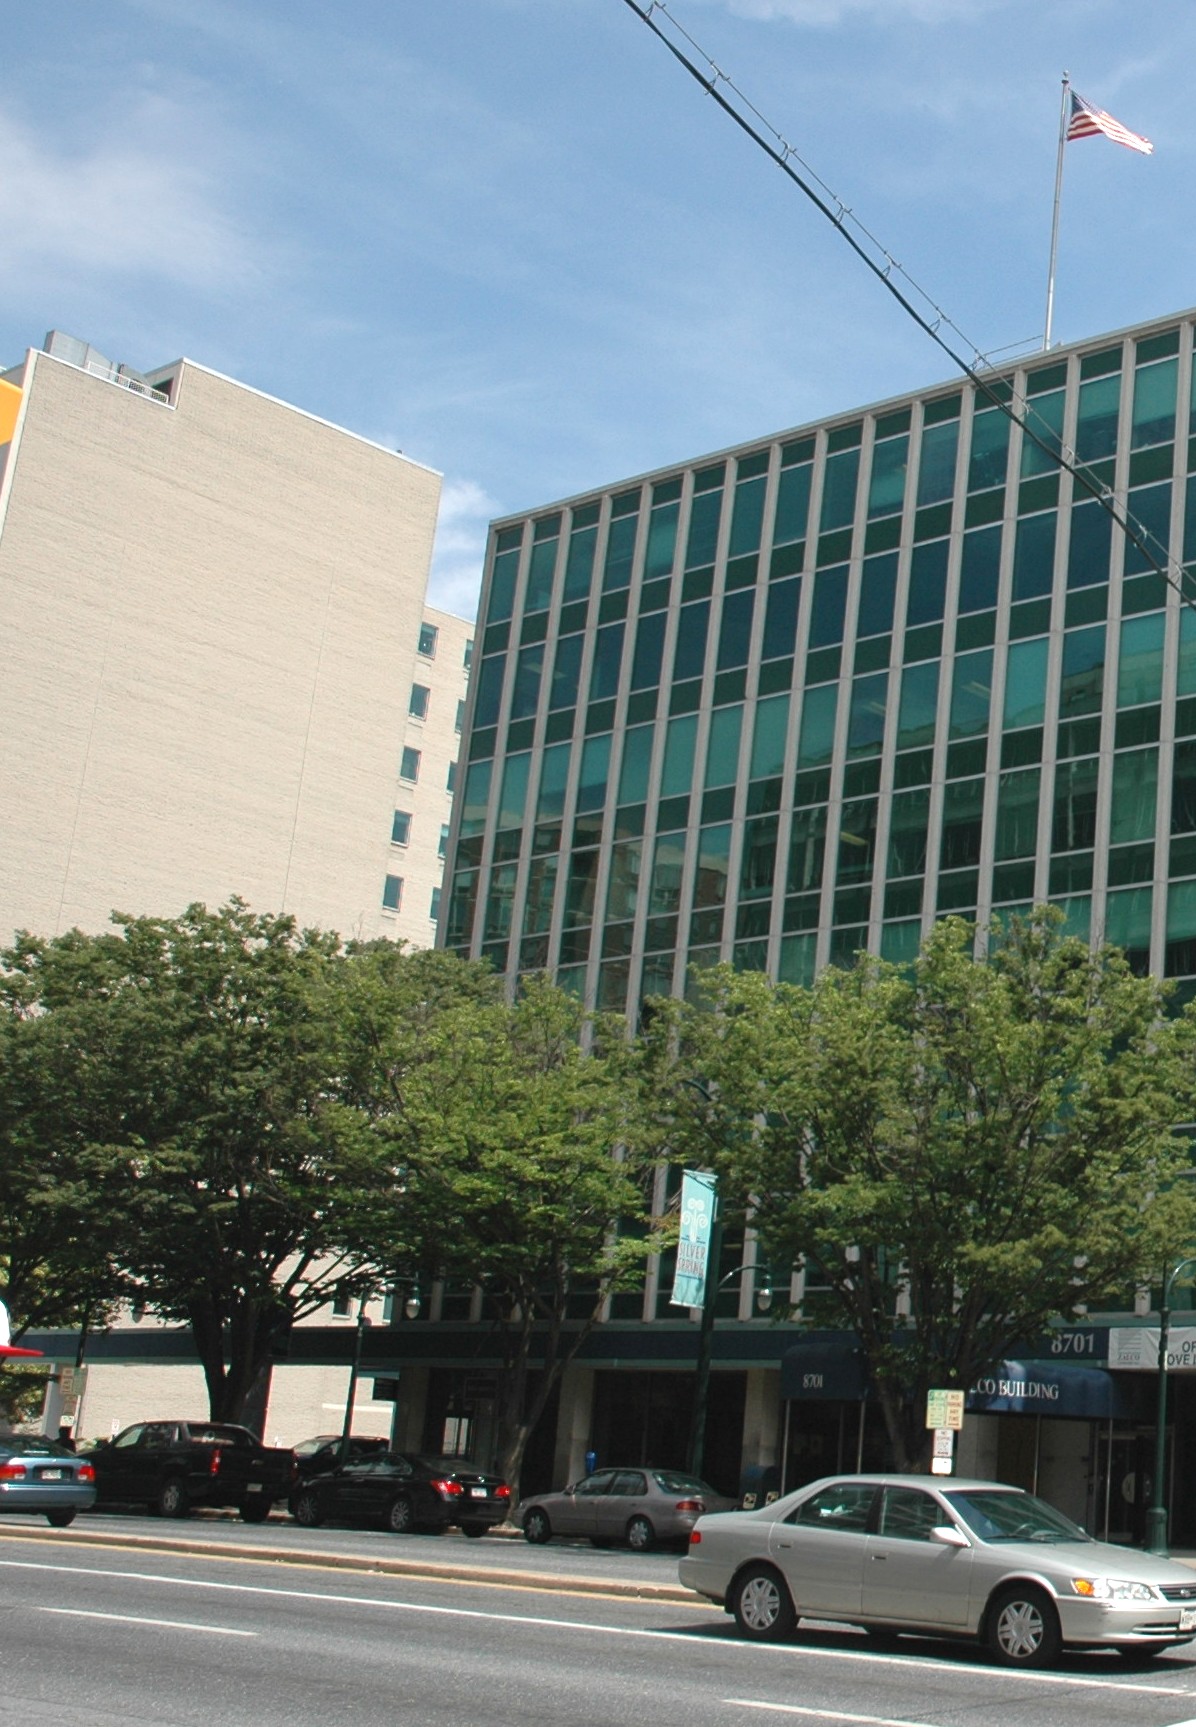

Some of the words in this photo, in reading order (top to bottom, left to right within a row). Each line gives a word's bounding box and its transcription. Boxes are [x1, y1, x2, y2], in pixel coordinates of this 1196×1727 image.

[1051, 1332, 1095, 1354] 8701
[1166, 1353, 1190, 1366] OVE
[998, 1379, 1060, 1400] BUILDING
